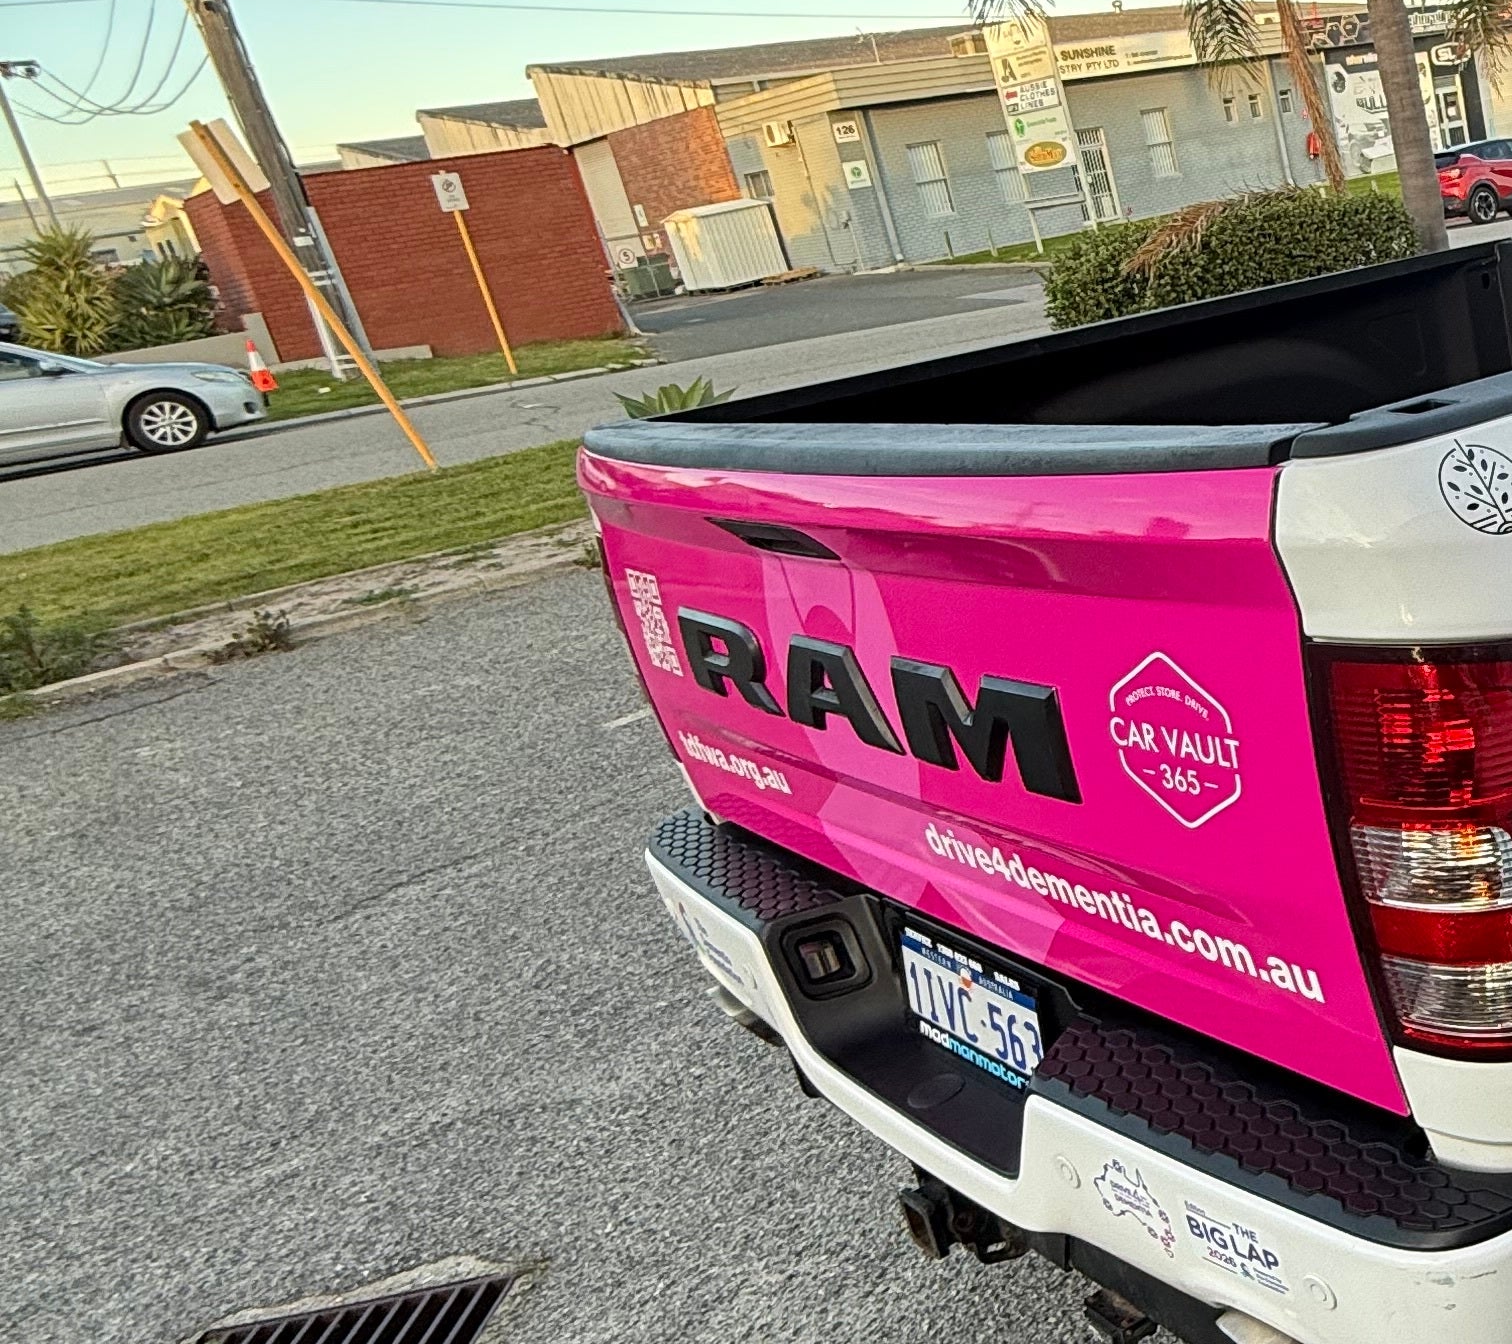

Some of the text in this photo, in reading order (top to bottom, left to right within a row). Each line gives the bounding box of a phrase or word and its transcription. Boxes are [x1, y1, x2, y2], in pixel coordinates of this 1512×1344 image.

[1060, 45, 1117, 62] SUNSHINE
[1087, 61, 1102, 71] PTY
[1104, 59, 1120, 69] LTD
[1020, 88, 1056, 101] CLOTHES
[677, 605, 1084, 805] RAM
[678, 730, 793, 796] tdfwa.org.au
[1109, 716, 1240, 769] CAR VAULT
[1159, 763, 1201, 795] 365
[924, 822, 1327, 1004] drive4dementia.com.au
[1185, 1214, 1280, 1271] BIG LAP
[1231, 1222, 1259, 1244] THE
